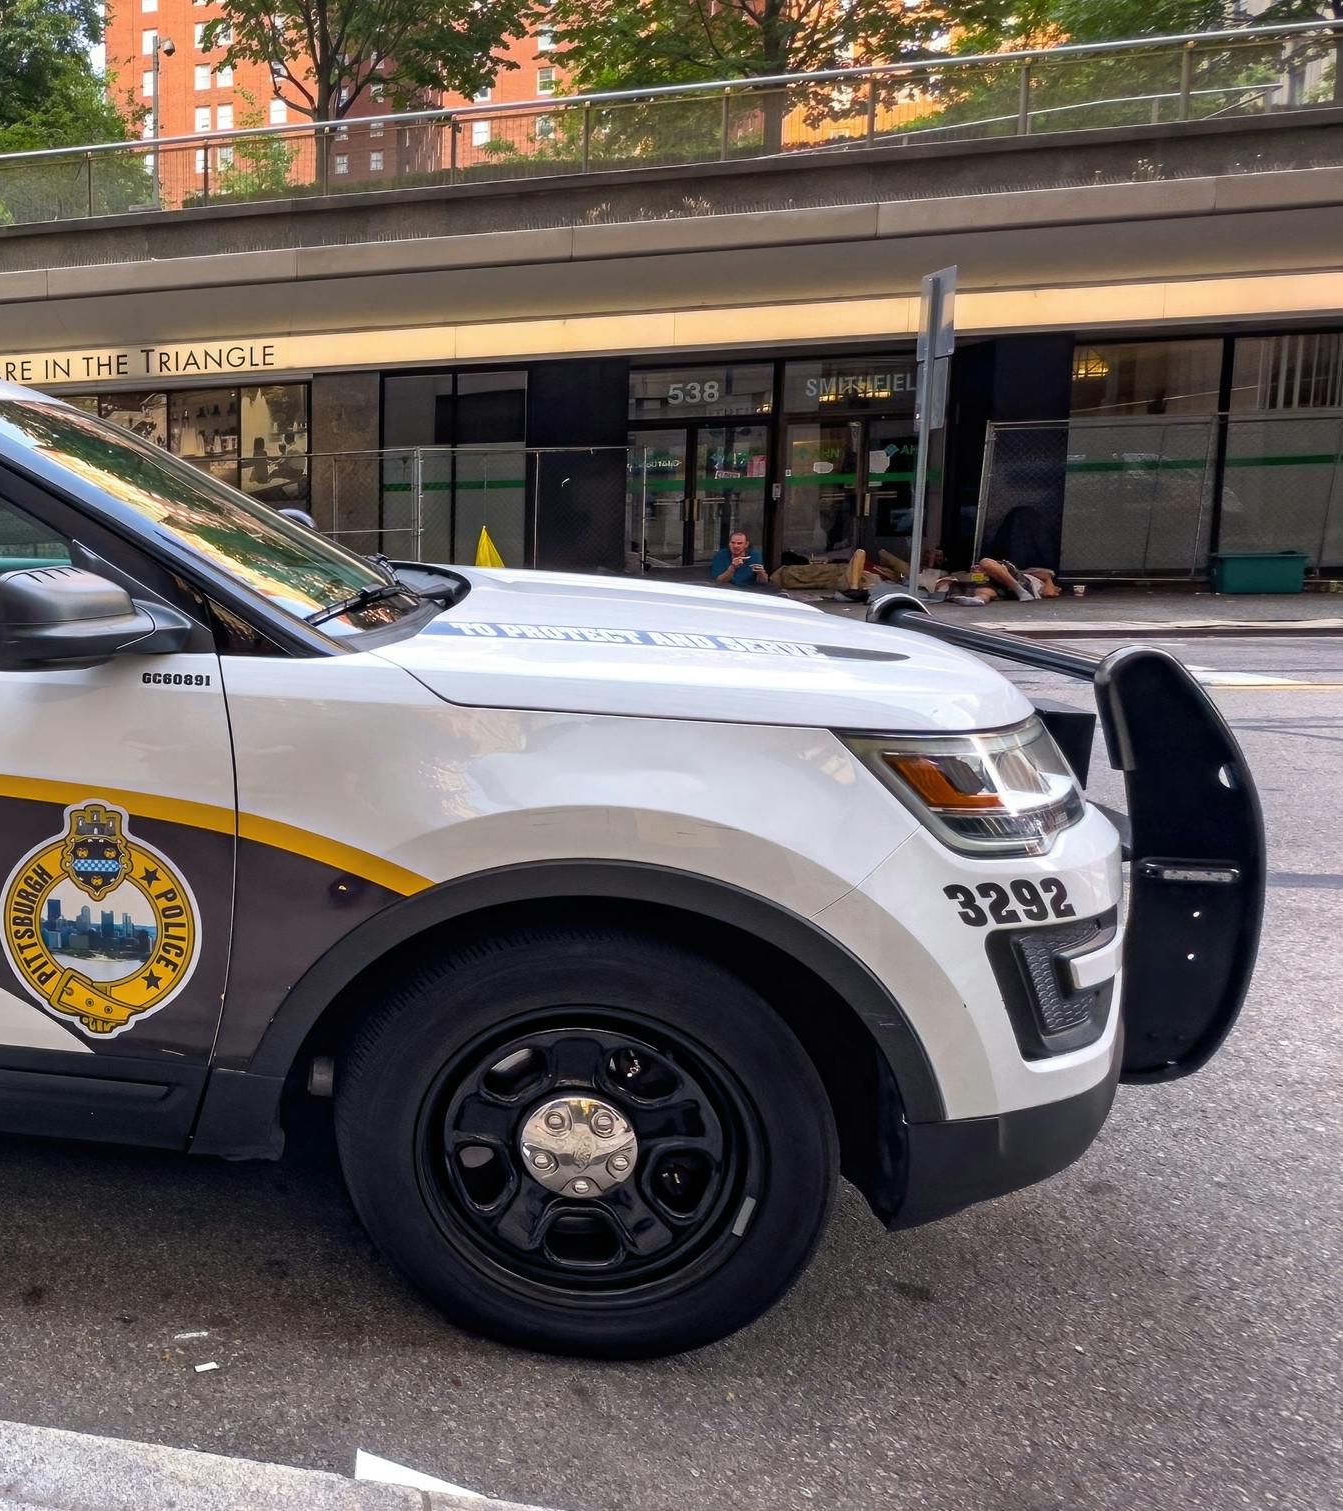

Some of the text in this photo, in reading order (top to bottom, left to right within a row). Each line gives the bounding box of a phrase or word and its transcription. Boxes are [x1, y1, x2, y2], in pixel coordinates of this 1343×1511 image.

[44, 359, 70, 379] IN
[82, 354, 128, 376] THE
[140, 345, 275, 373] TRIANGLE
[667, 381, 719, 404] 538
[805, 373, 917, 397] SMITHFIEL
[449, 623, 828, 659] TO PROTECT AND SERVE
[142, 672, 211, 686] GC60891
[942, 876, 1077, 928] 3292
[13, 864, 55, 986] PITTSBURGH
[154, 887, 187, 975] POLICE
